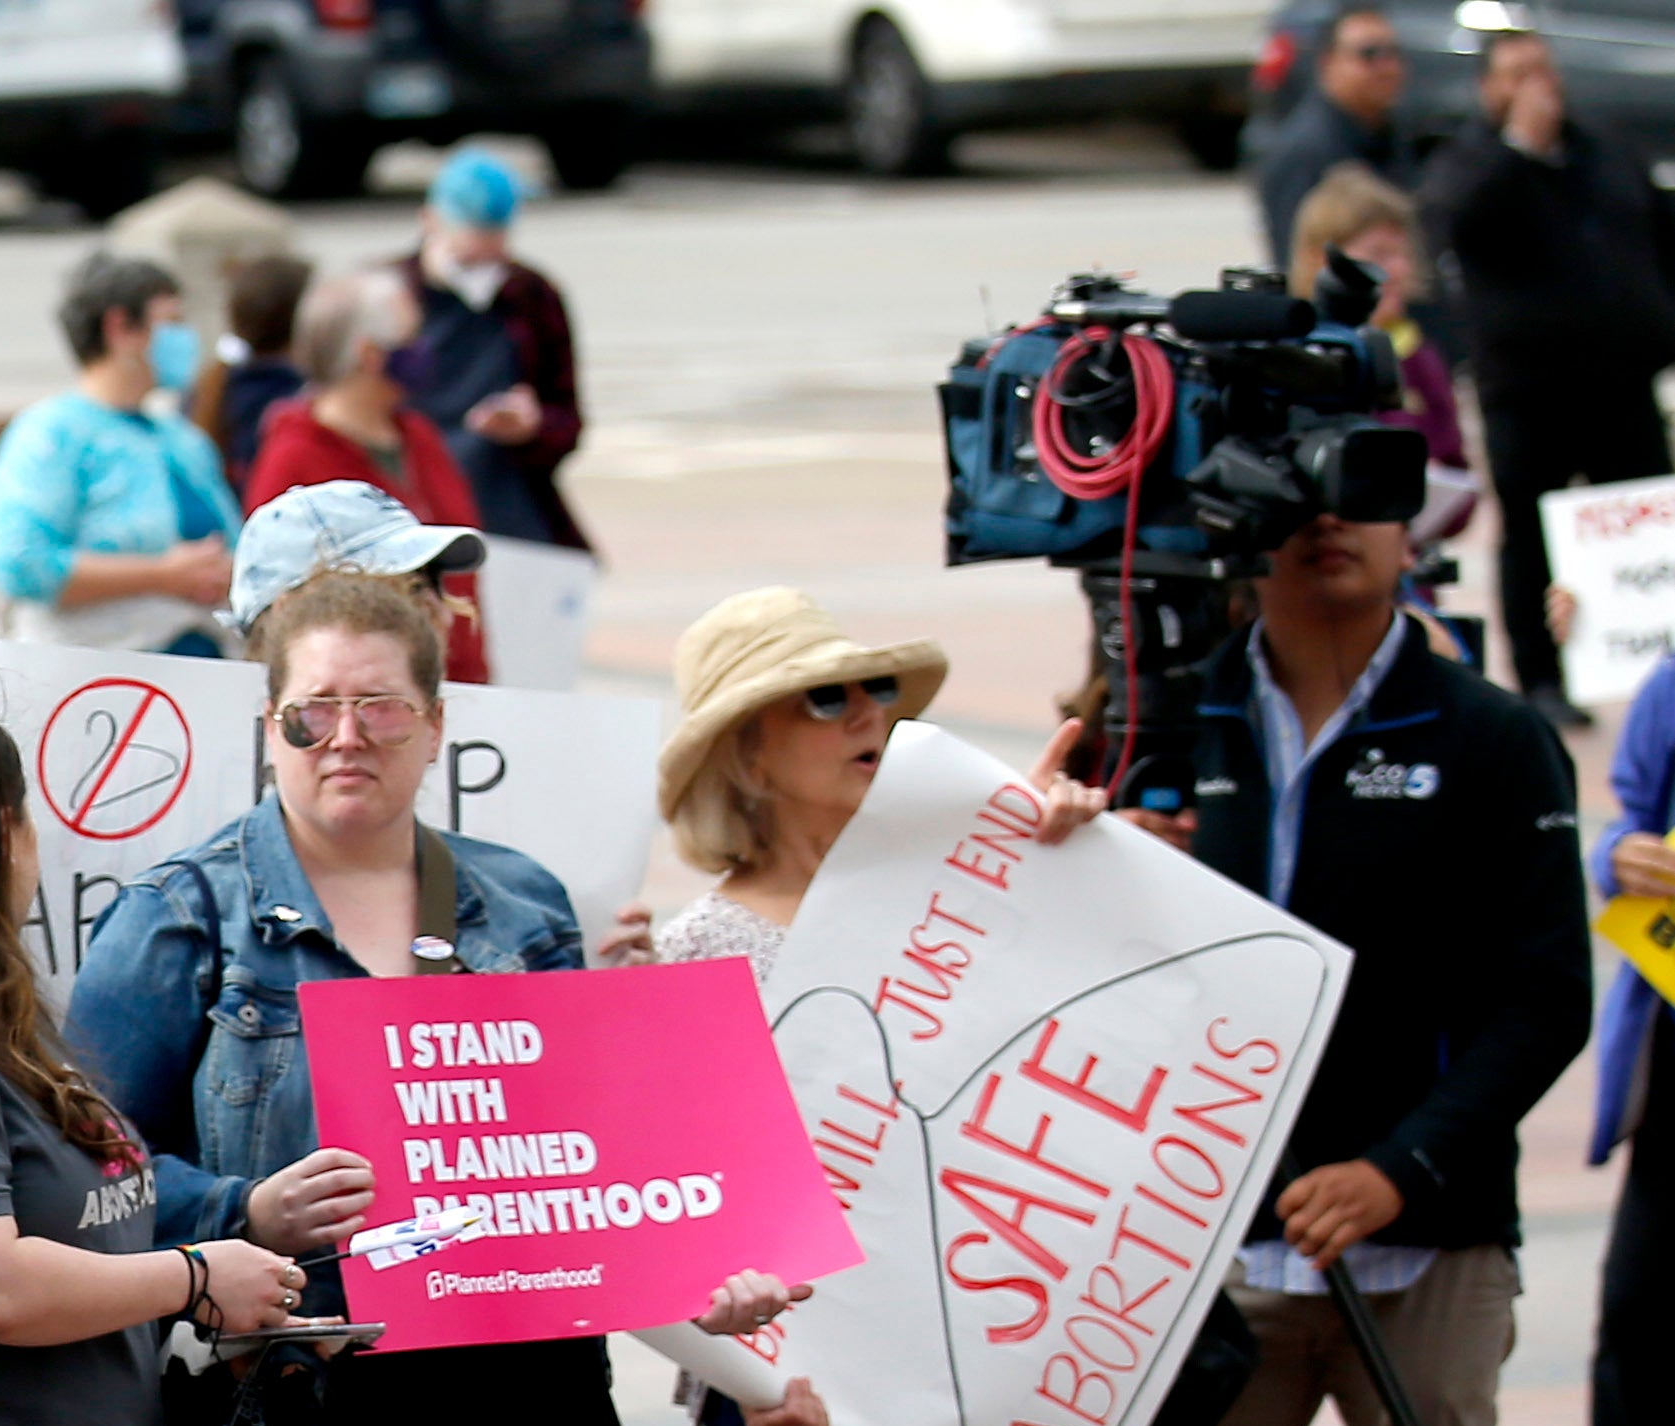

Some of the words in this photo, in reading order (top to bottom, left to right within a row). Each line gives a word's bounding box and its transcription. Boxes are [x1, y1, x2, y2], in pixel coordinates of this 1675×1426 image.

[872, 892, 988, 1042] JUST
[944, 781, 1045, 892] END
[383, 1025, 405, 1069] I
[408, 1020, 544, 1069] STAND
[394, 1077, 508, 1126] WITH
[403, 1131, 598, 1183] PLANNED
[939, 1018, 1168, 1345] SAFE
[445, 1270, 506, 1296] Planned
[506, 1266, 602, 1292] Parenthood
